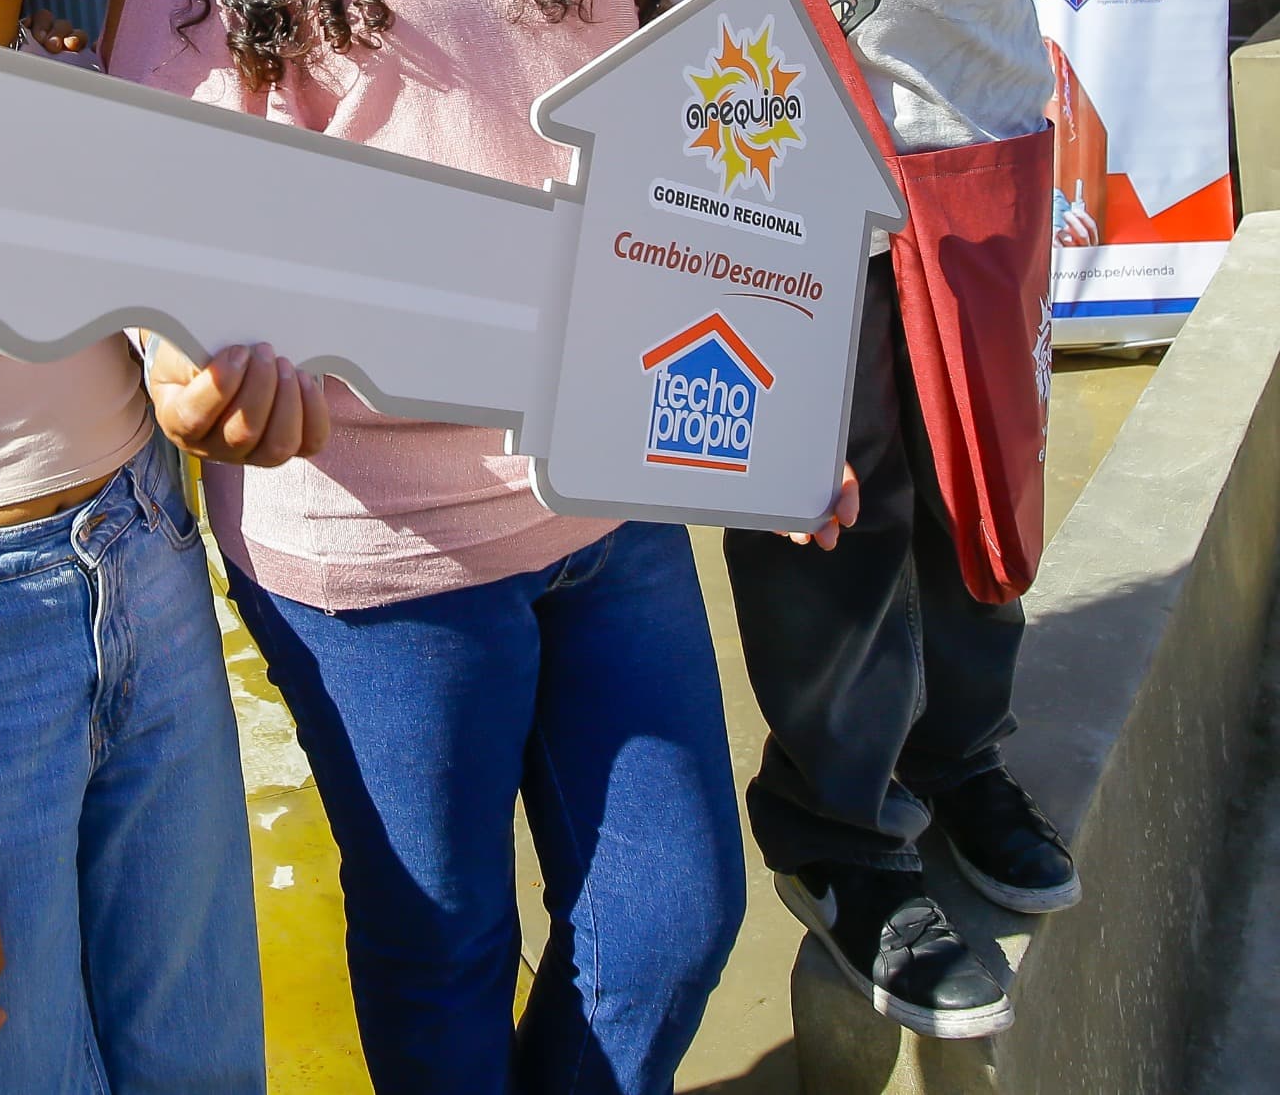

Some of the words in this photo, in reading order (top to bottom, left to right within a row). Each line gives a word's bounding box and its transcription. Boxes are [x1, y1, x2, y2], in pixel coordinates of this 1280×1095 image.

[654, 185, 730, 219] GOBIERNO
[733, 206, 804, 239] REGIONAL
[659, 369, 750, 416] techo
[656, 408, 752, 458] propio
